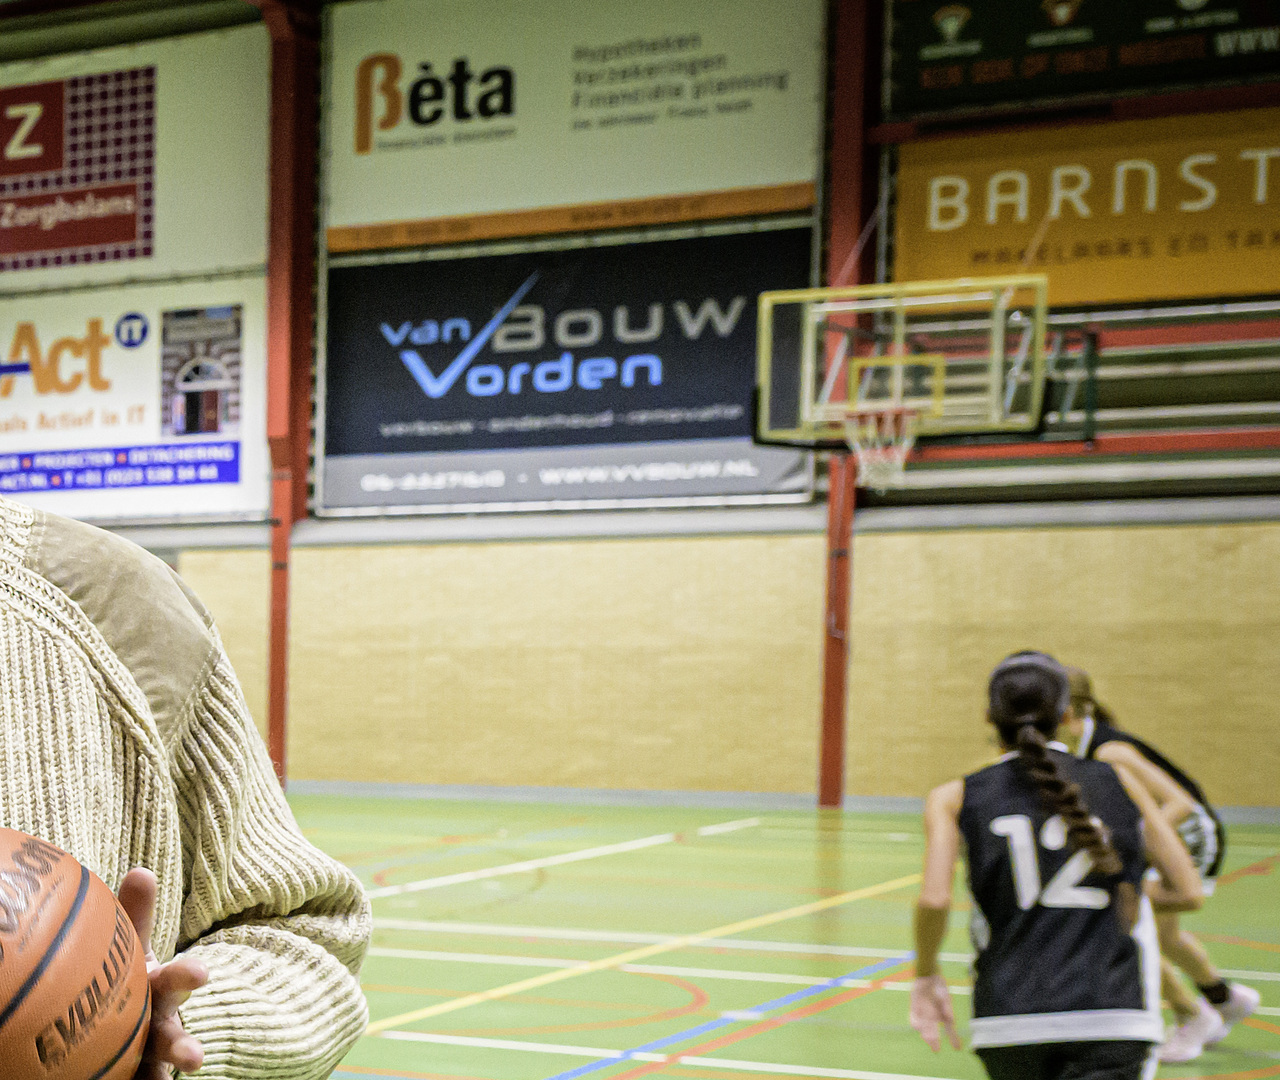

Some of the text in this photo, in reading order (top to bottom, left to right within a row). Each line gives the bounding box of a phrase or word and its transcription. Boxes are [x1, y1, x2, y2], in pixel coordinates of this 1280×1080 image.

[691, 71, 790, 99] planning
[4, 104, 43, 160] Z
[380, 317, 471, 347] van
[399, 318, 663, 399] Vorden
[989, 814, 1111, 911] 12
